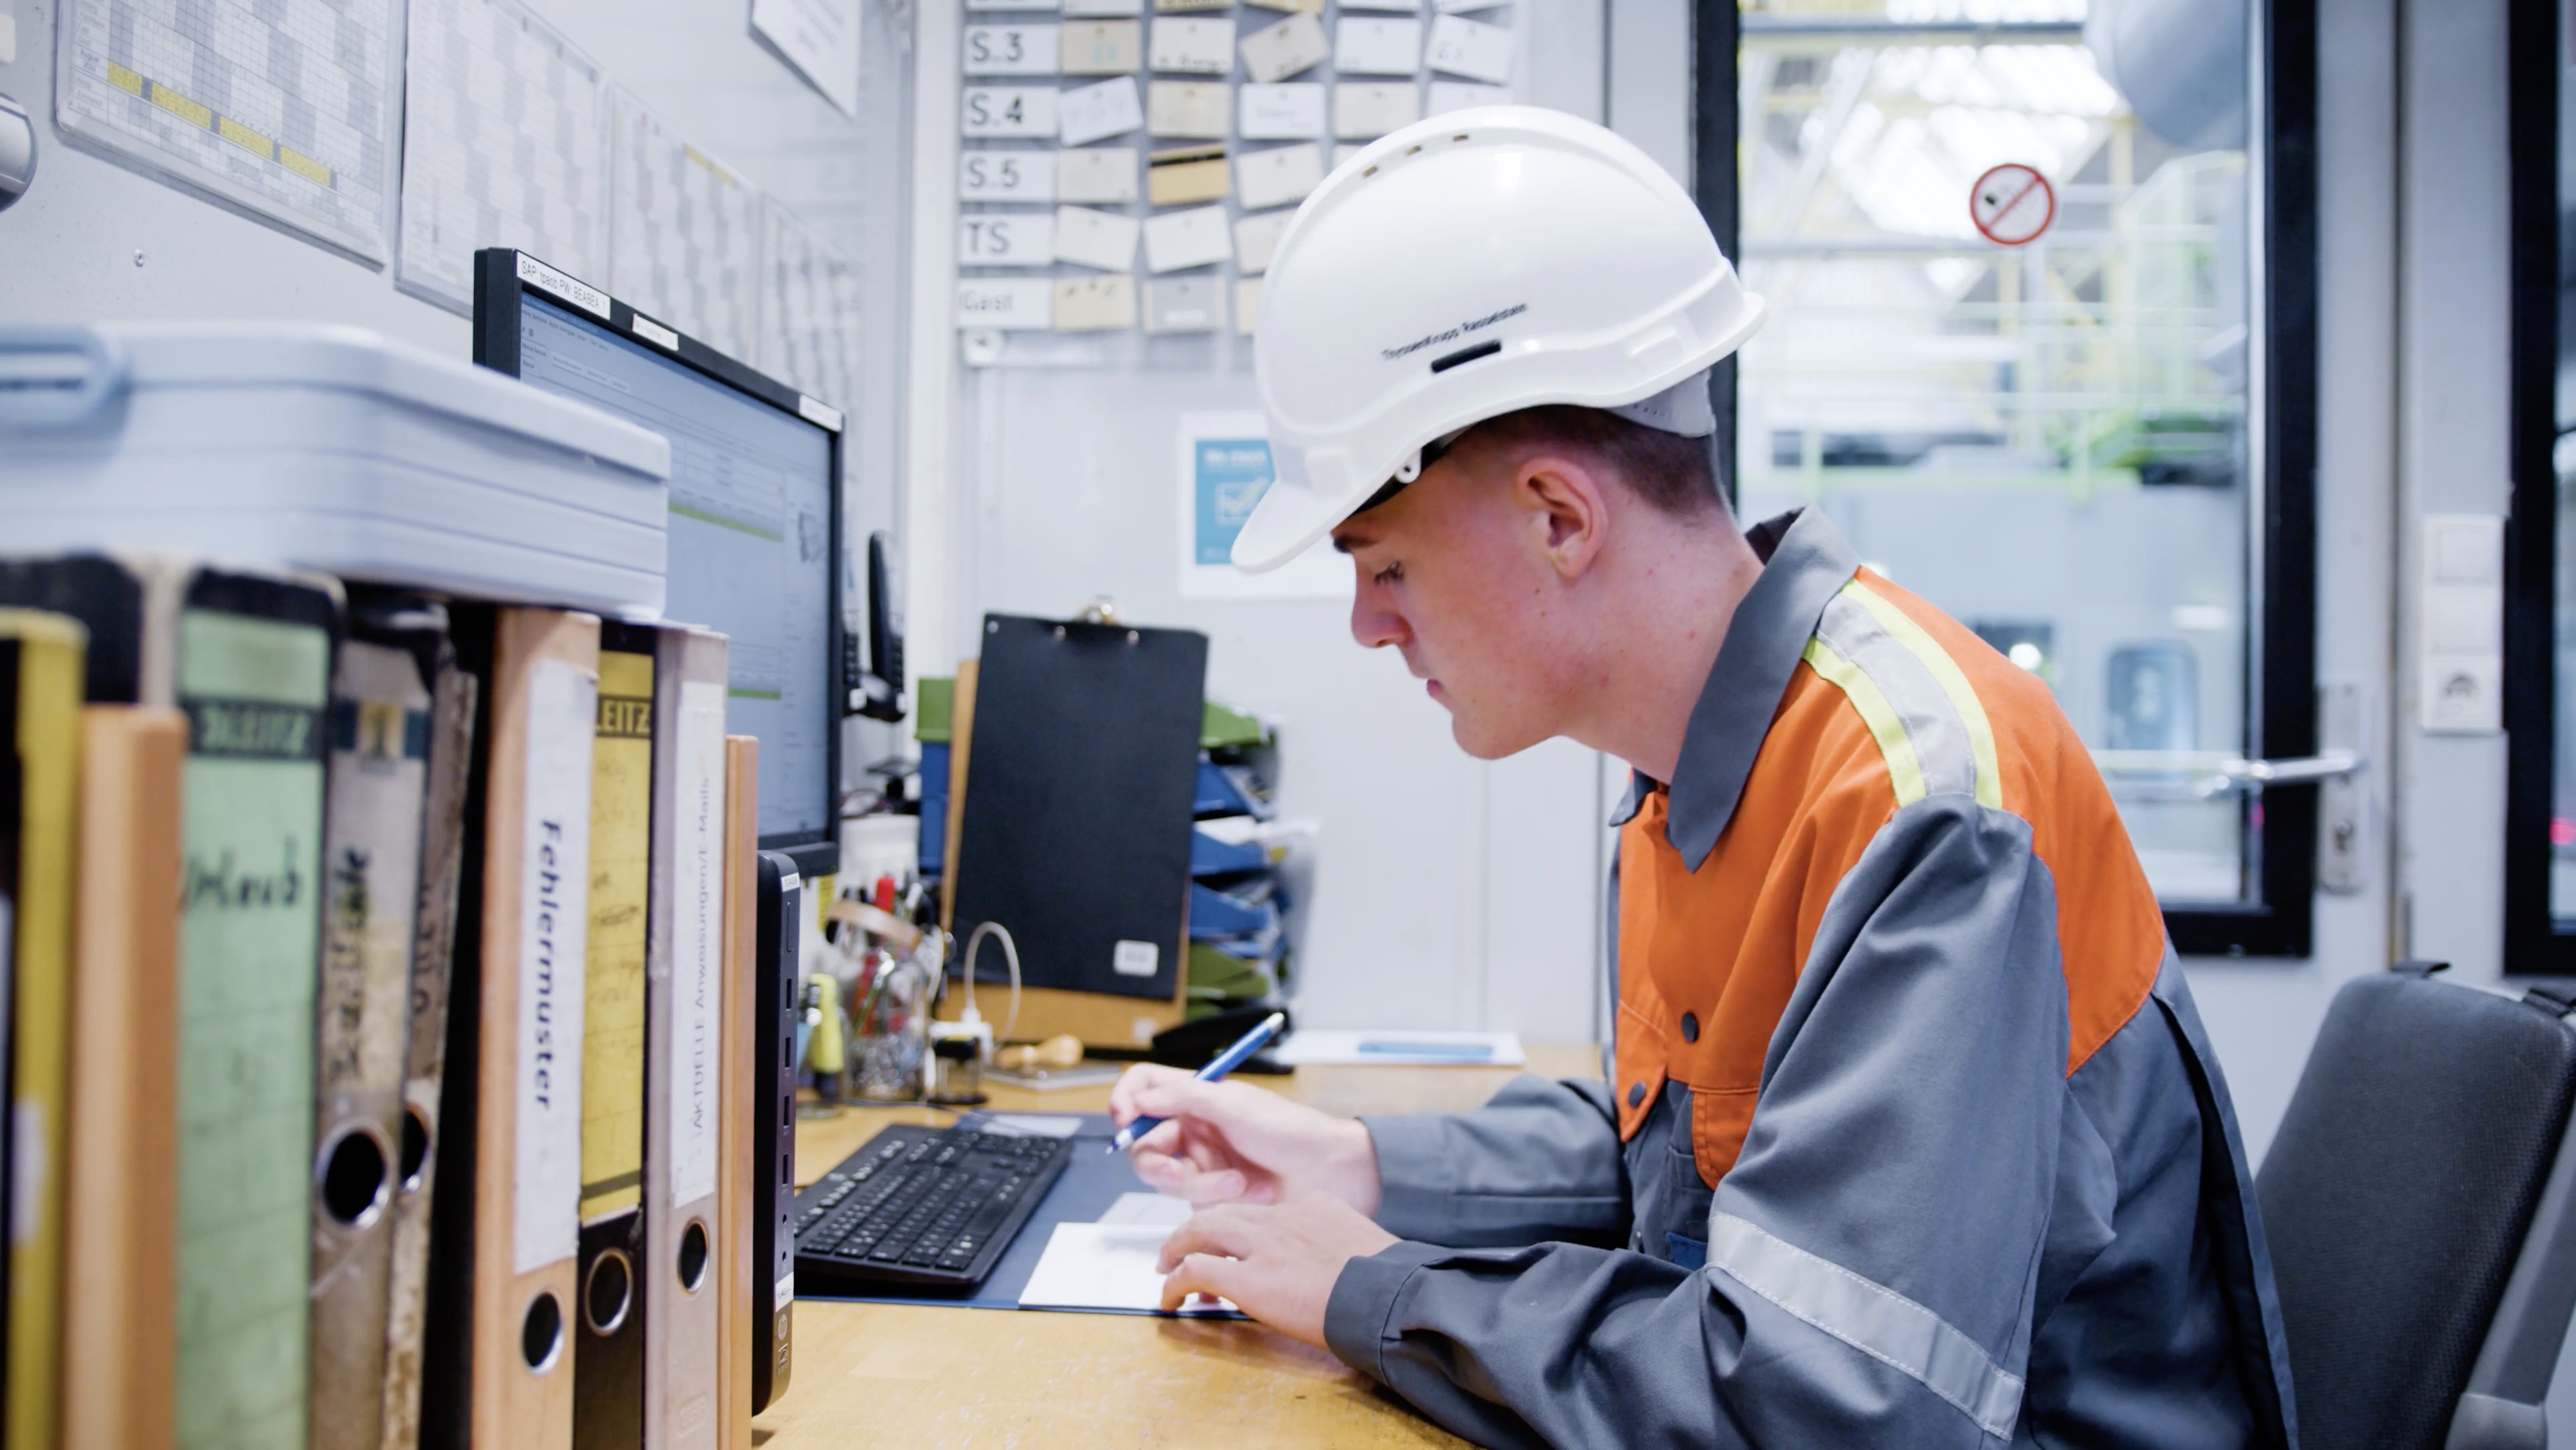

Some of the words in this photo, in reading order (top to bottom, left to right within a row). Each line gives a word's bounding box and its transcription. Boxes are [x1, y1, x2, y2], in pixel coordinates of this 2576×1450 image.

[971, 31, 1024, 64] S.3
[970, 93, 1023, 126] S.4
[967, 156, 1020, 189] S.5
[967, 221, 1009, 254] TS
[536, 819, 562, 1110] Fehlermuster
